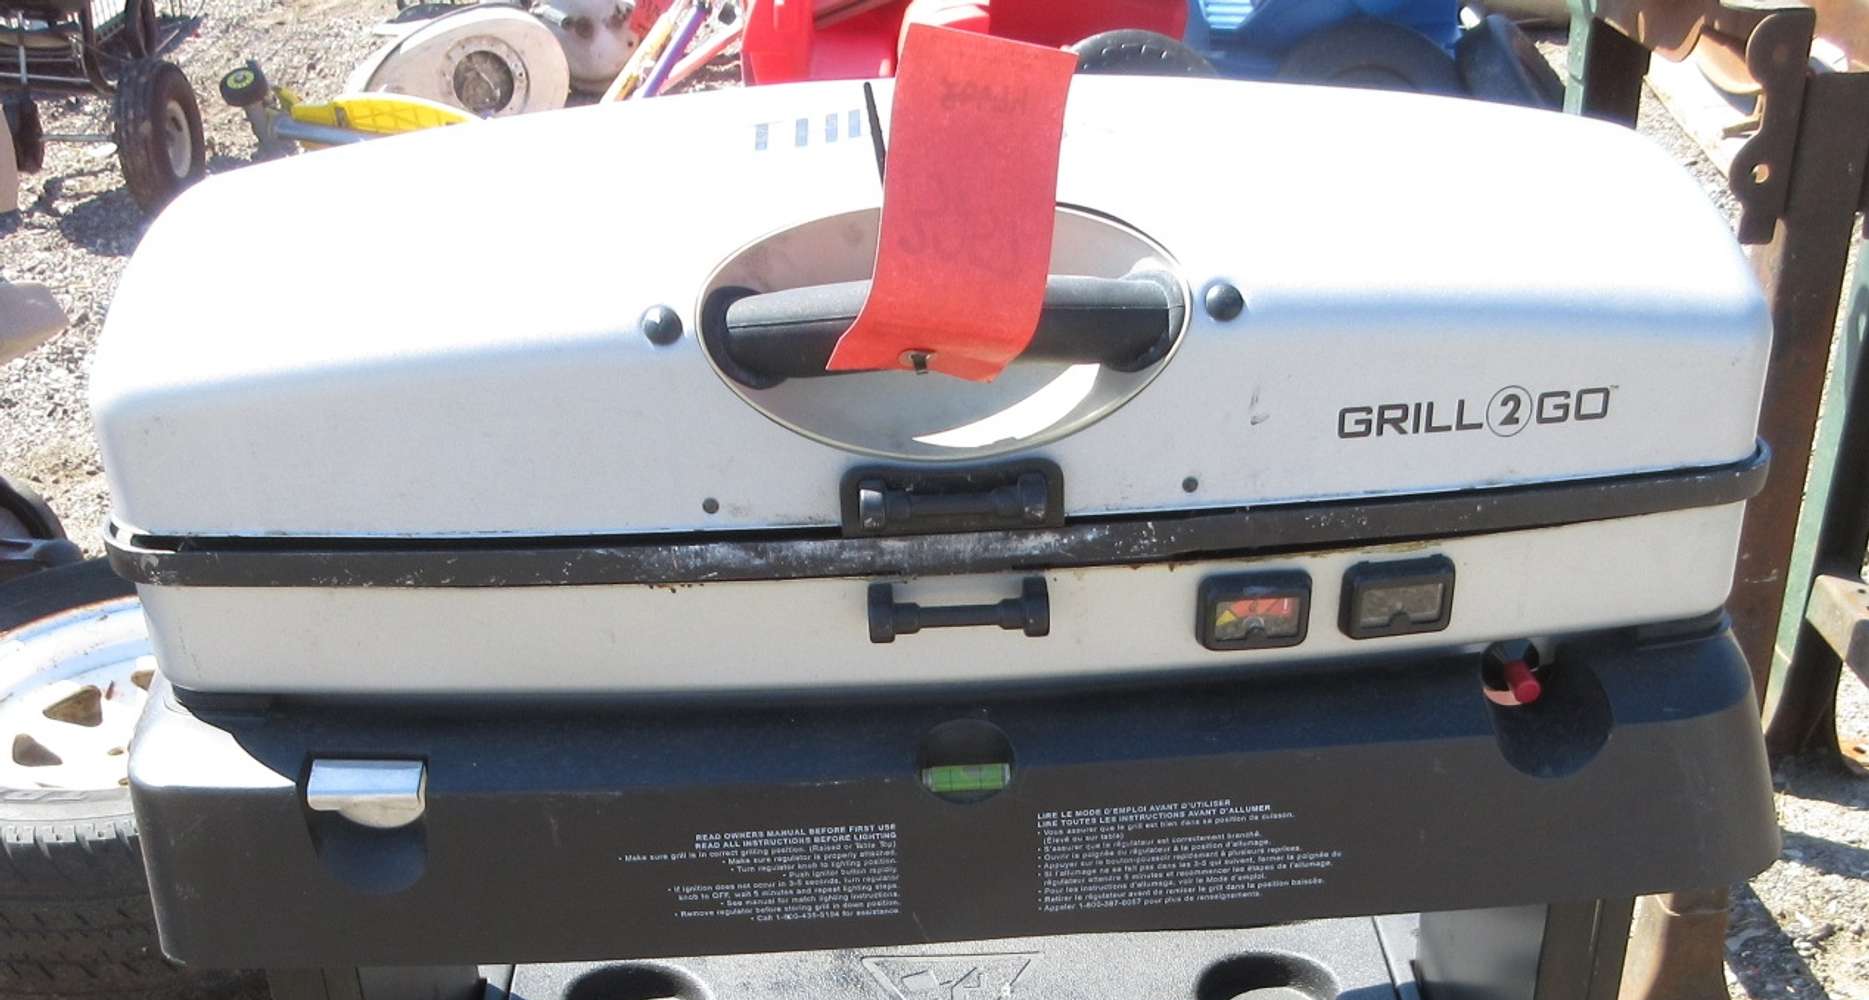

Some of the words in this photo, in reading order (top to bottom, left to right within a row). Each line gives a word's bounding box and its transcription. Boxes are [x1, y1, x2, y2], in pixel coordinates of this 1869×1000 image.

[1150, 803, 1178, 811] AVANT
[1188, 808, 1216, 817] AVANT
[767, 828, 805, 837] MANUAL
[809, 826, 845, 835] BEFORE
[849, 824, 874, 832] FIRST
[743, 837, 810, 847] INSTRUCTIONS
[814, 834, 850, 843] BEFORE
